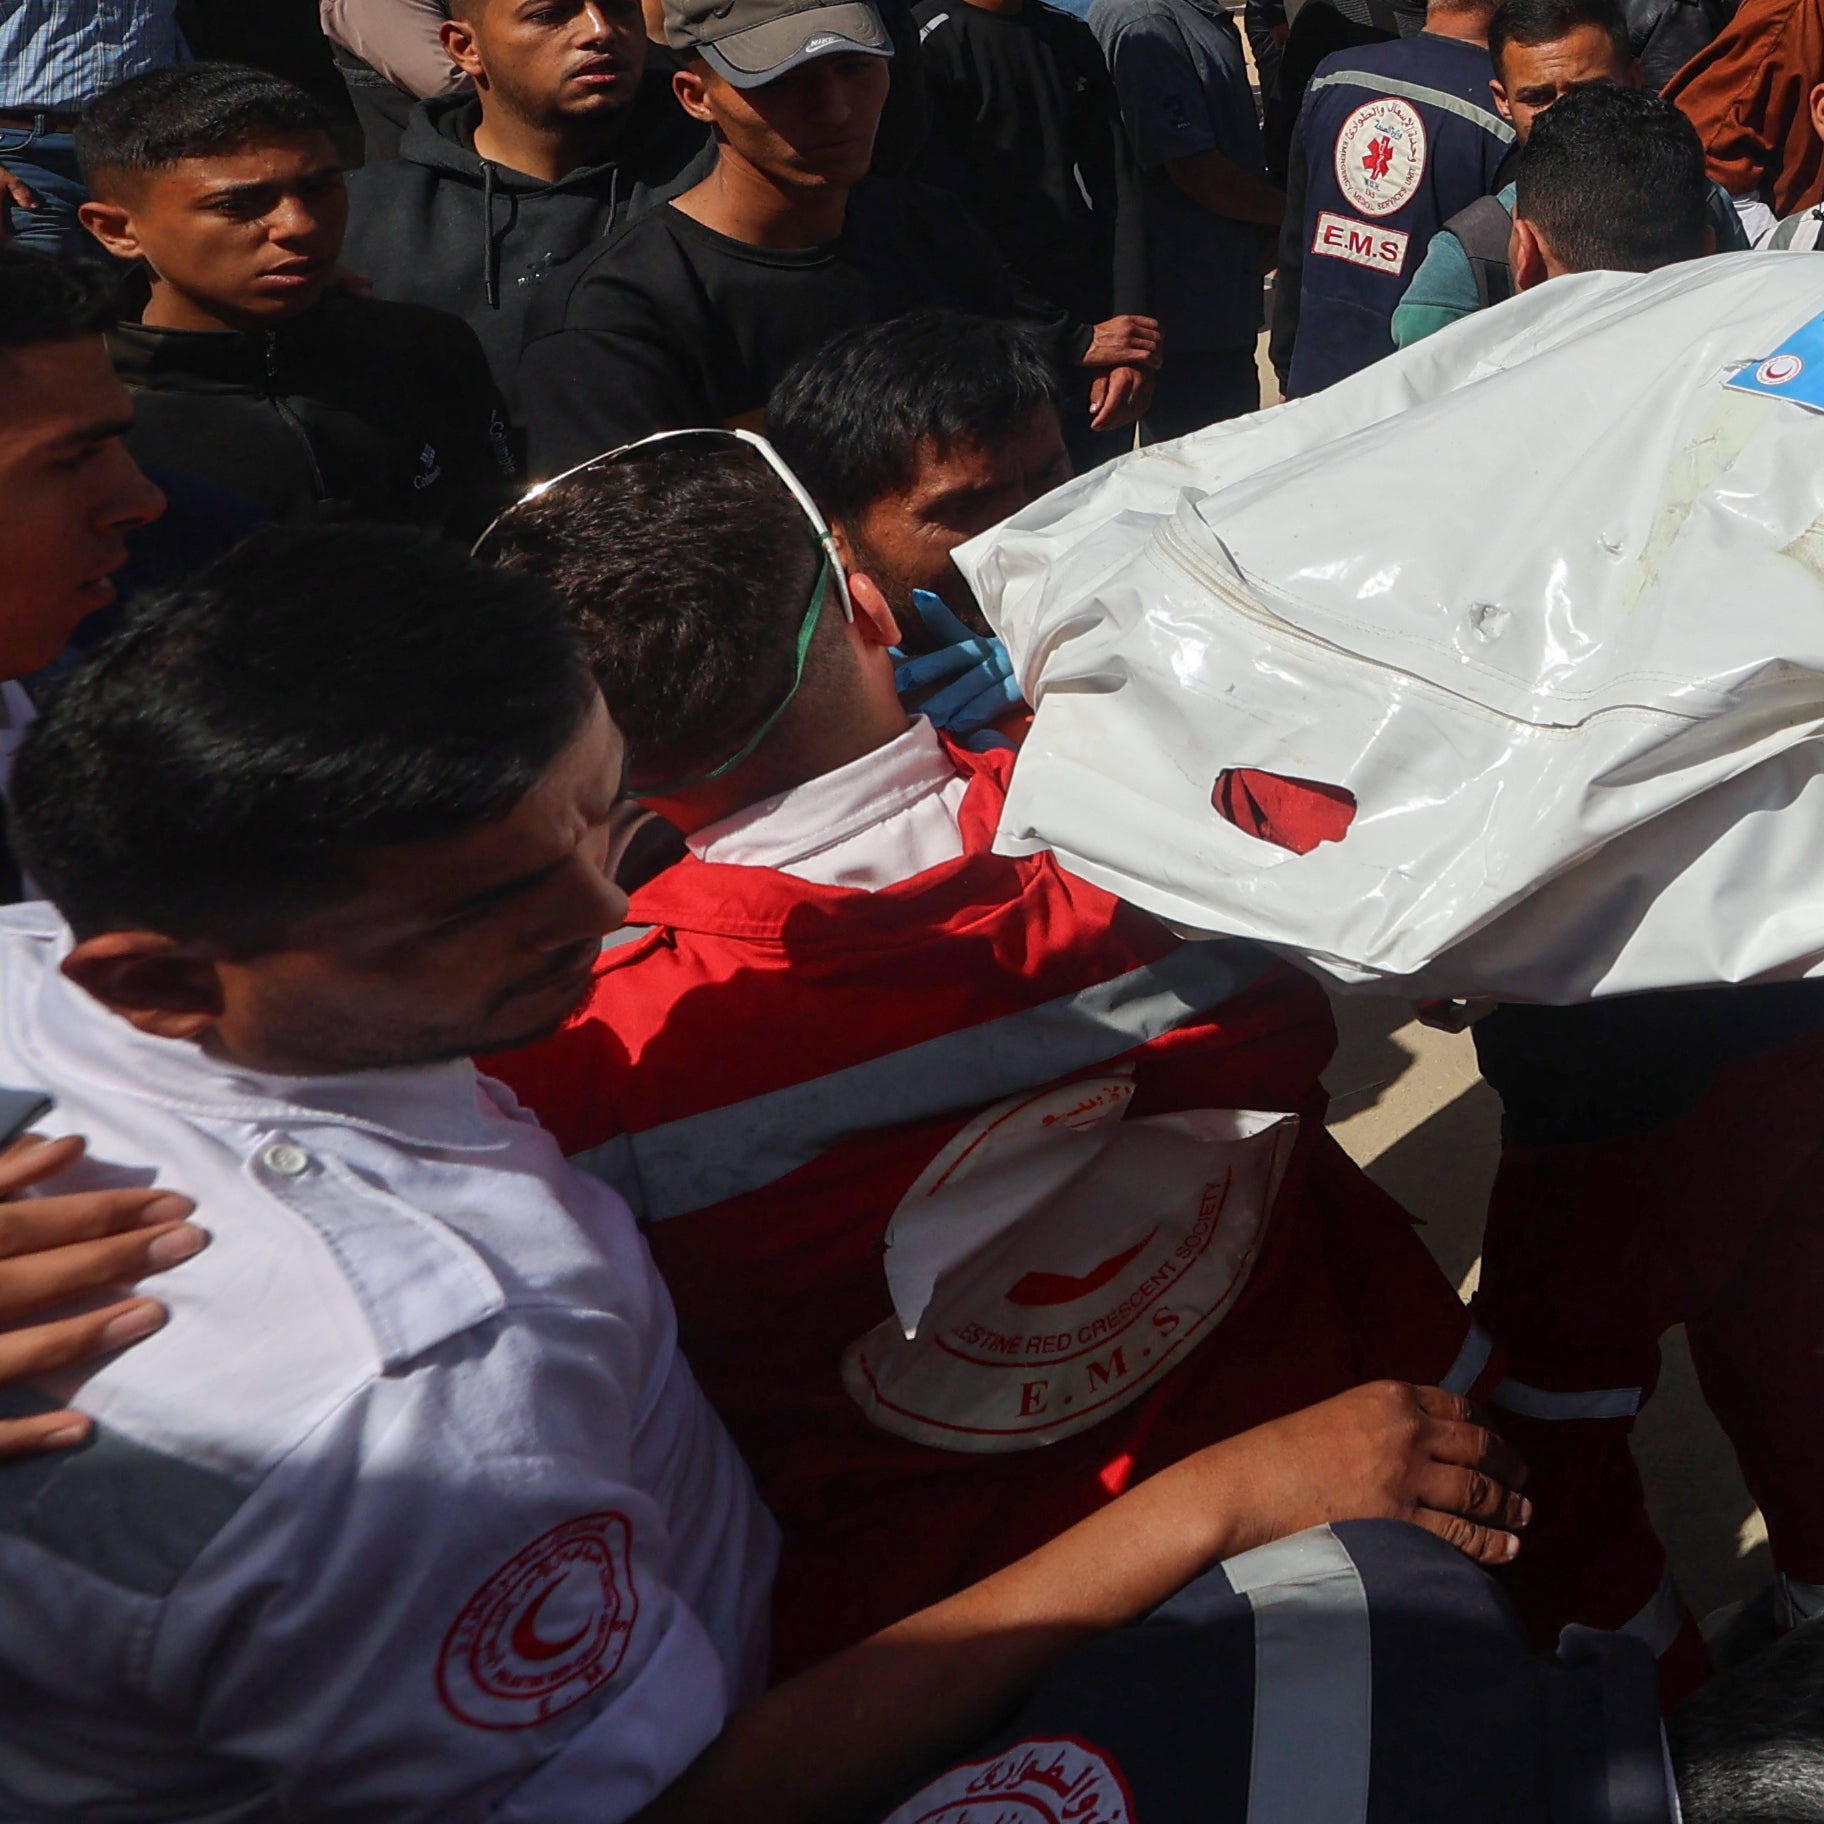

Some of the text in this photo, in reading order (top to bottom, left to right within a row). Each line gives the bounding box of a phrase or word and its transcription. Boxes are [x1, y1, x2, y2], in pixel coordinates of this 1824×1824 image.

[1323, 224, 1399, 262] E.M.S
[958, 1180, 1222, 1355] ESTINE RED CRESCENT SOCIETY
